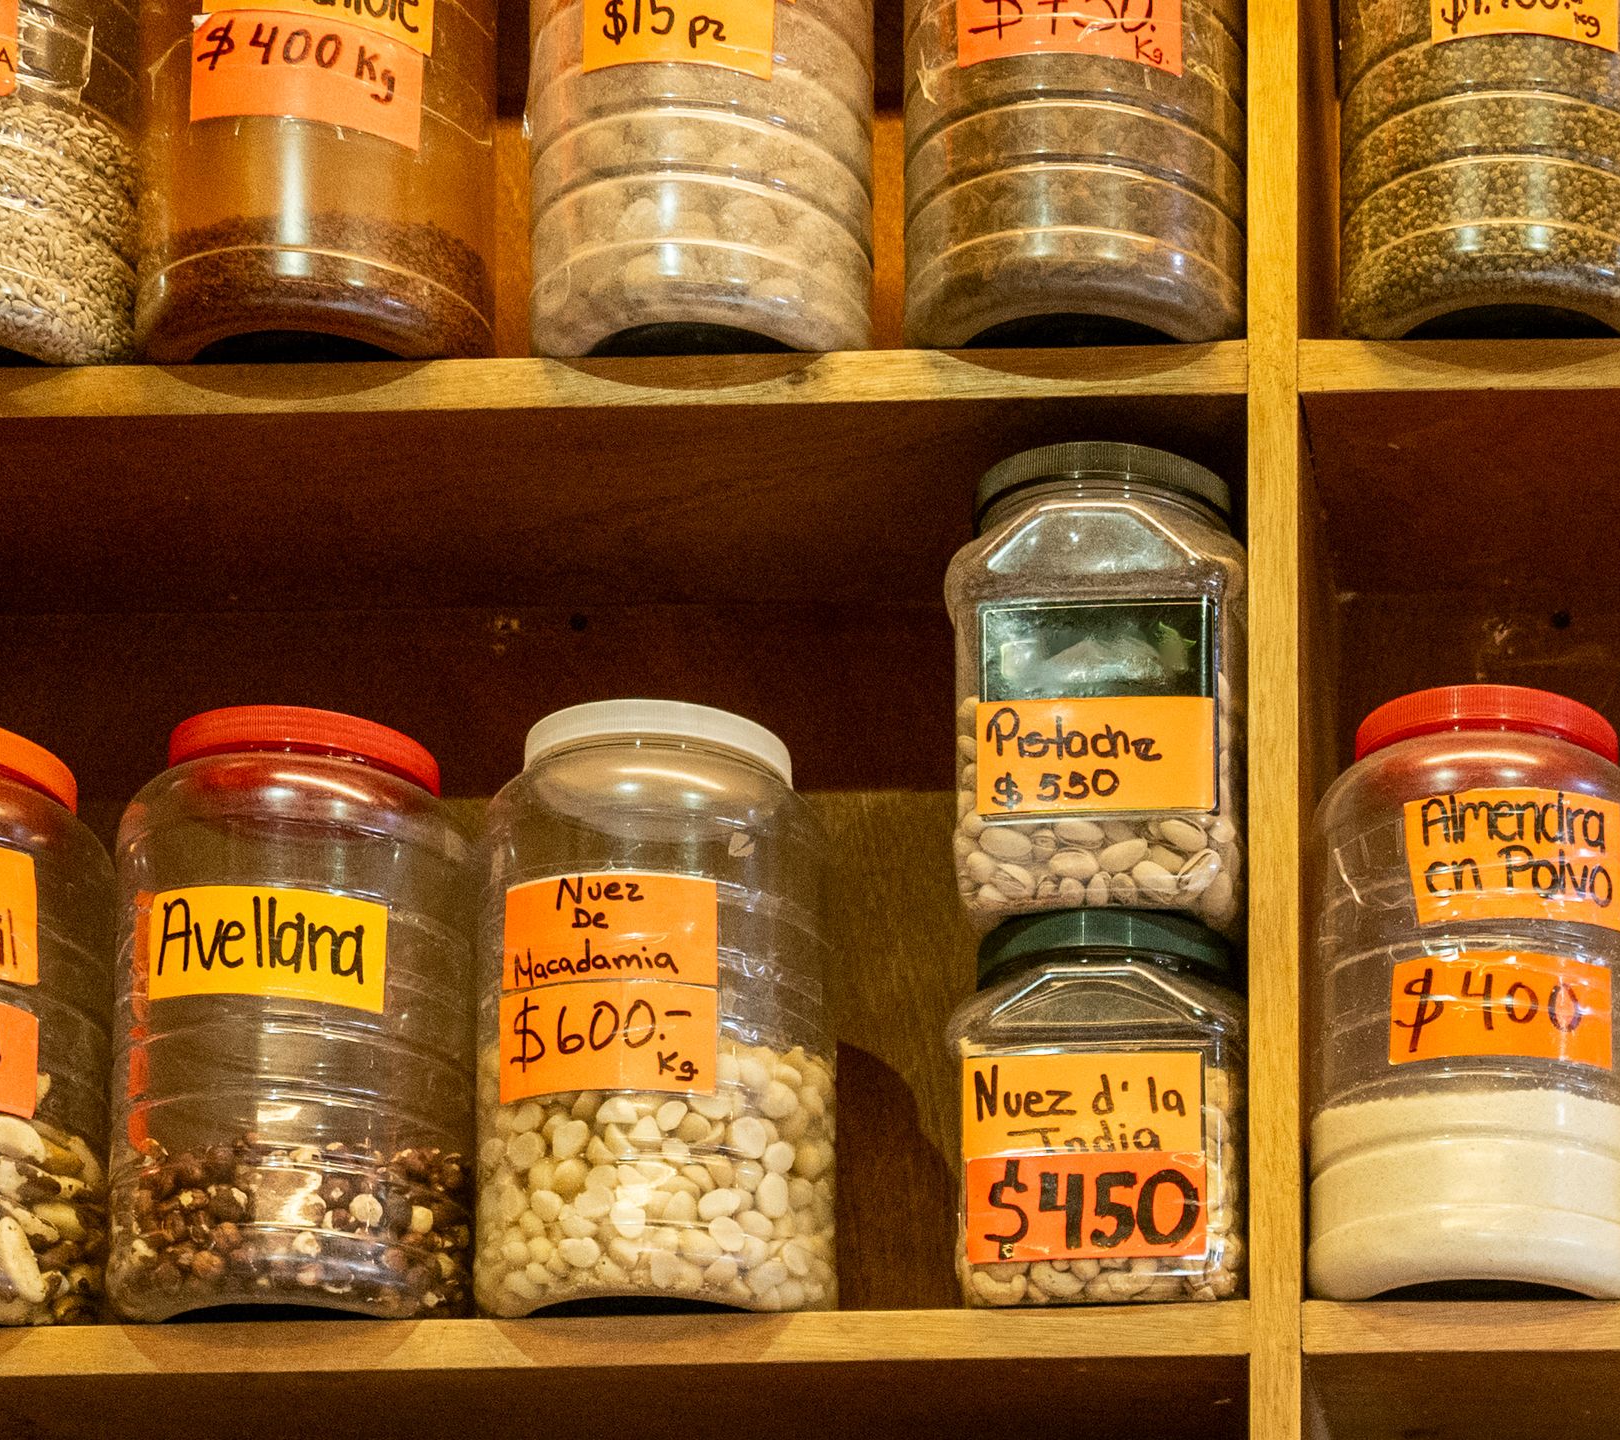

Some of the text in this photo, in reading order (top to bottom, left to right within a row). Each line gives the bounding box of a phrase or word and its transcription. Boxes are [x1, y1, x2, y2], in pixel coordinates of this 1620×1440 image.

[196, 18, 396, 104] $400 Kg
[1421, 791, 1606, 854] Almendra
[556, 876, 645, 911] Nuez
[1423, 845, 1613, 908] en Polvo
[157, 895, 364, 984] Avellana
[571, 907, 609, 930] De
[513, 938, 679, 988] Macadamia
[974, 1064, 1077, 1122] Nuez
[1147, 1076, 1187, 1117] la
[1007, 1119, 1163, 1152] India
[984, 1160, 1201, 1260] $450
